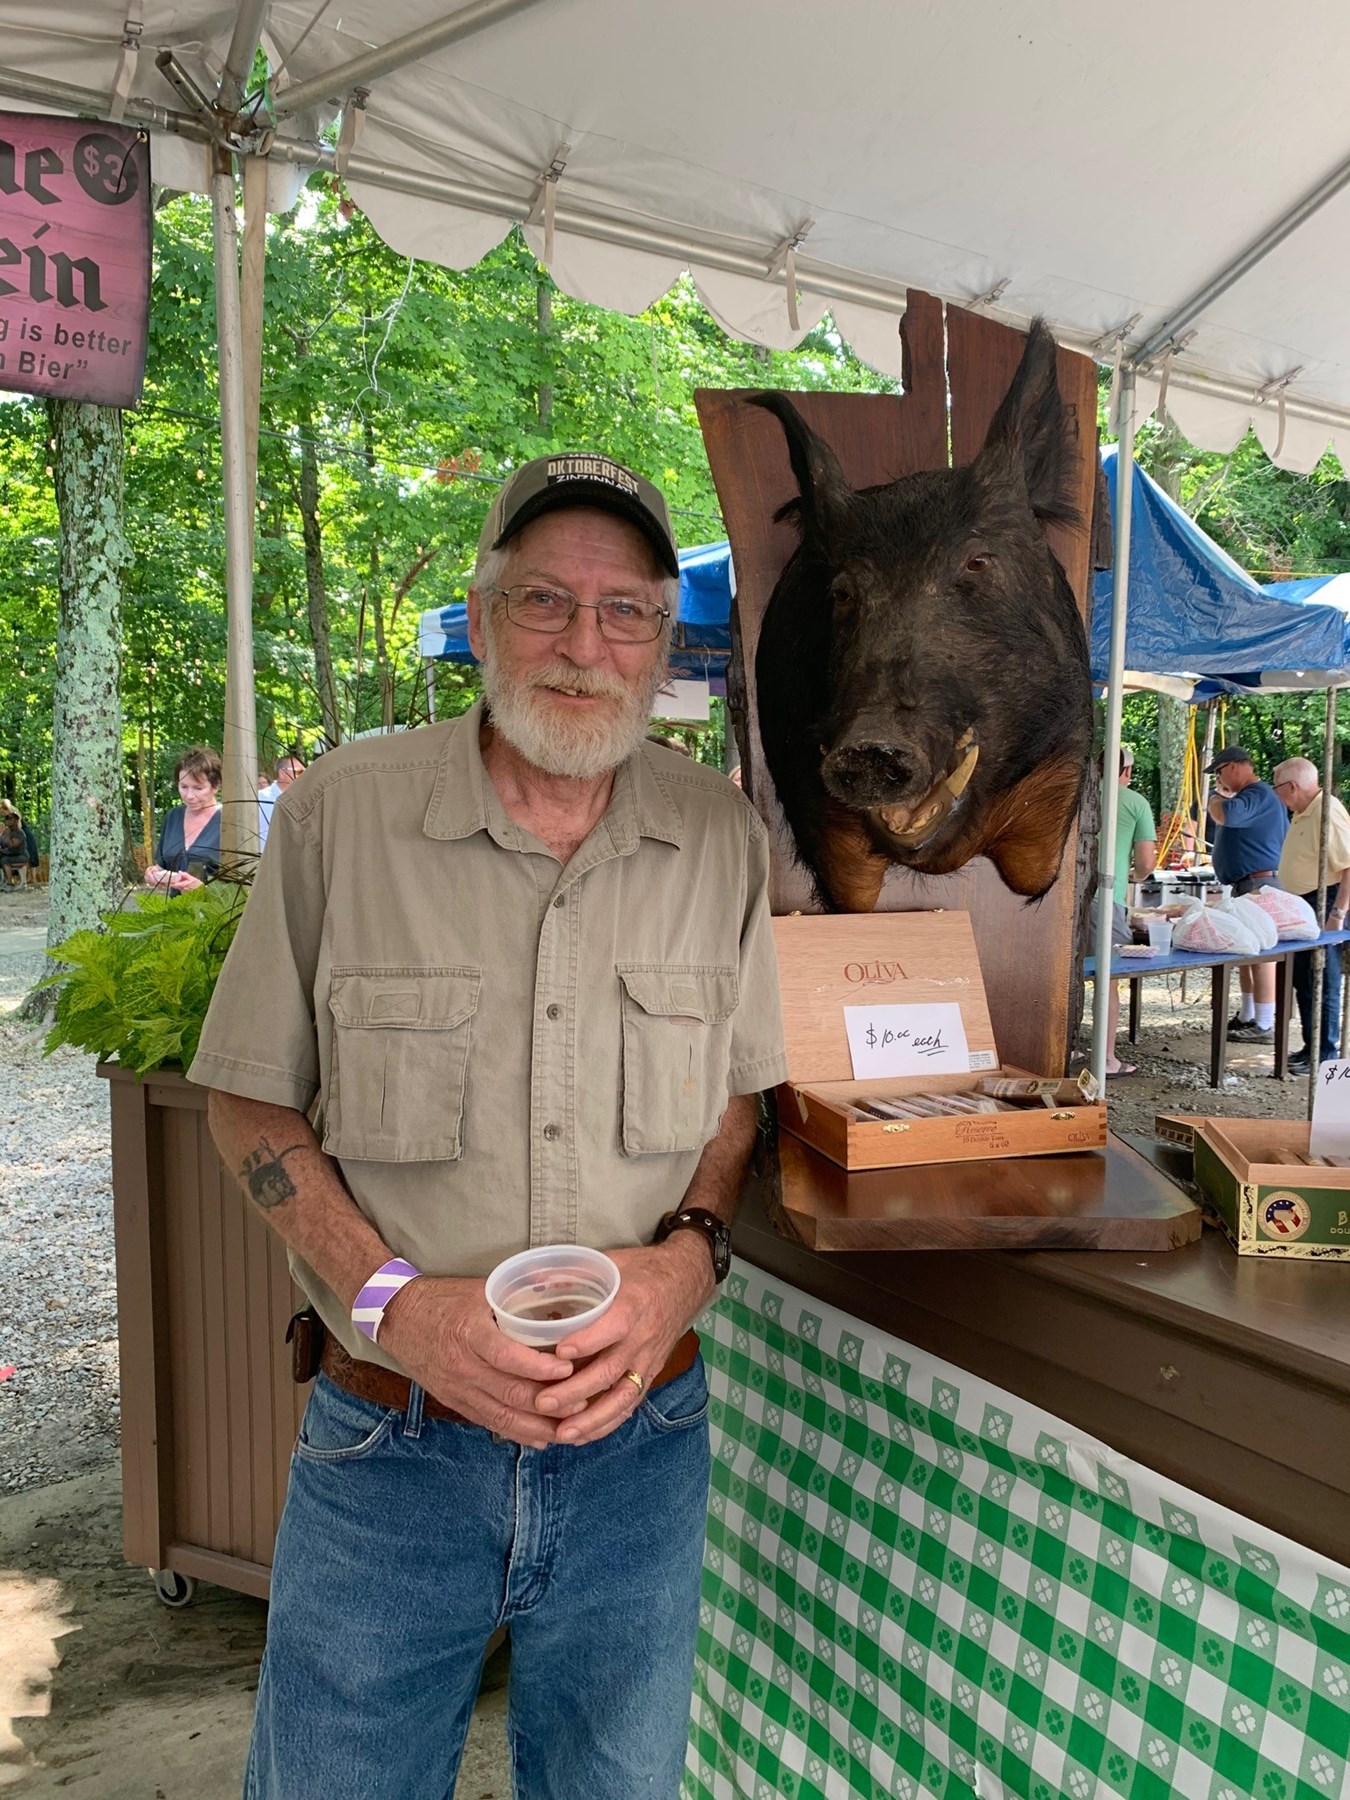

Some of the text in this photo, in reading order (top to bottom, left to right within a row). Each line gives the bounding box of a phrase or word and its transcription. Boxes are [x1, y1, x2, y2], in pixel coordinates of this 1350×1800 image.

[83, 144, 127, 194] $3
[20, 317, 42, 342] is
[54, 323, 132, 356] better
[547, 459, 639, 493] OKTOBERFEST
[911, 1029, 943, 1048] each
